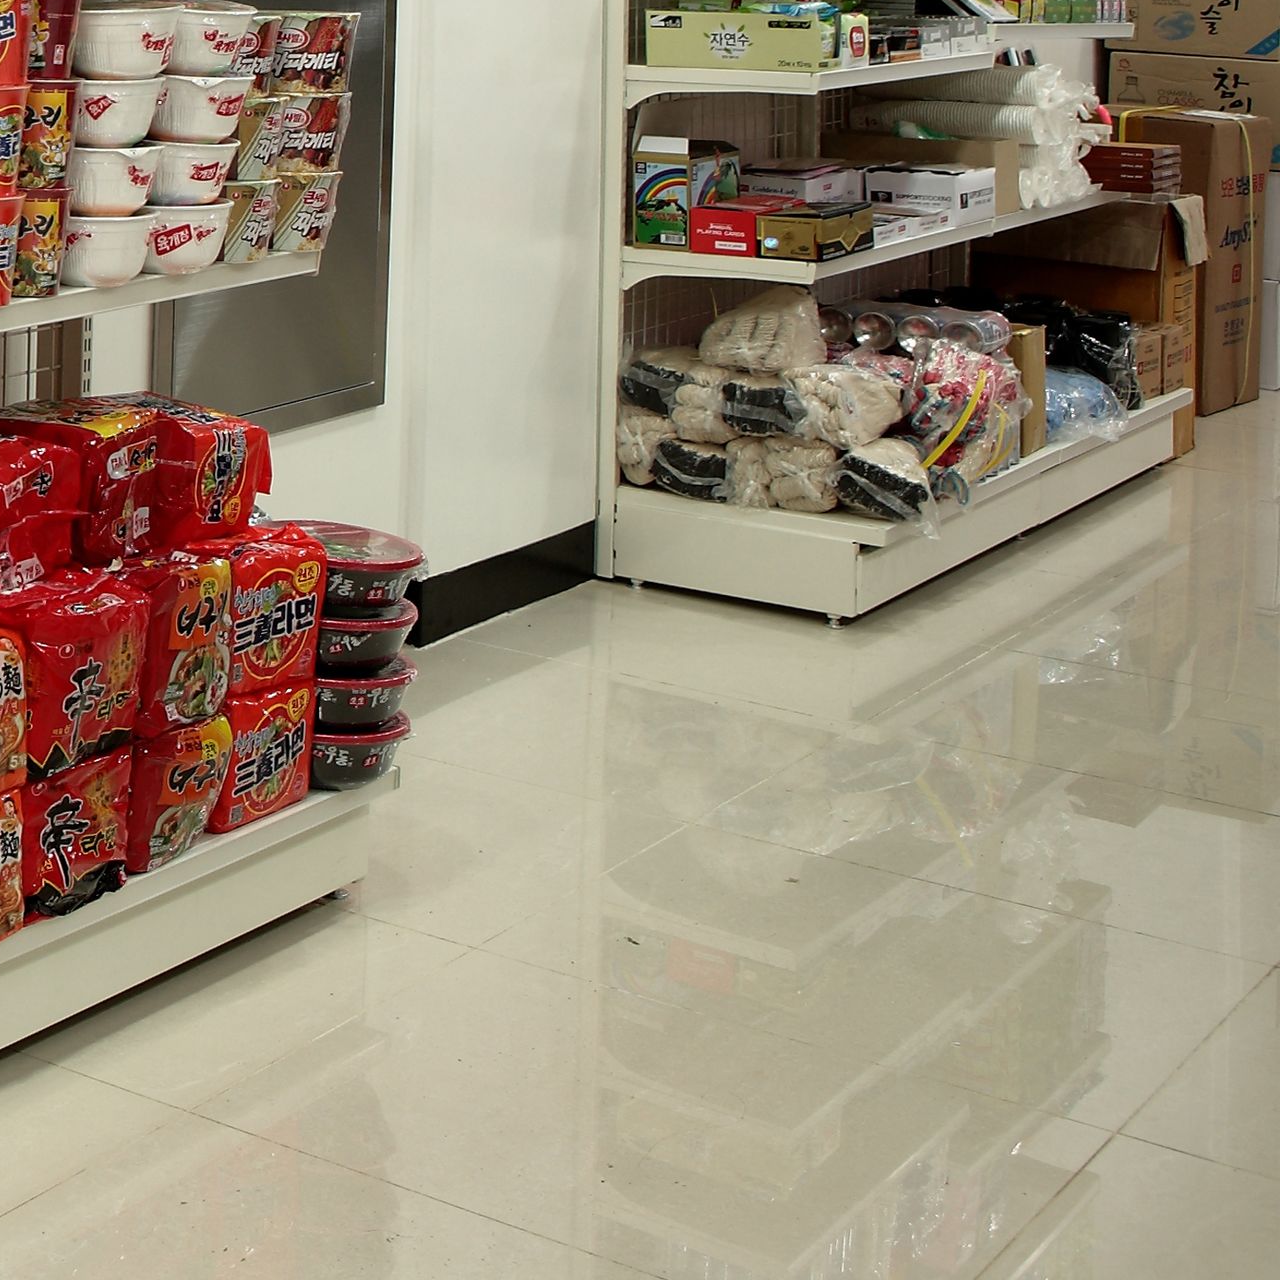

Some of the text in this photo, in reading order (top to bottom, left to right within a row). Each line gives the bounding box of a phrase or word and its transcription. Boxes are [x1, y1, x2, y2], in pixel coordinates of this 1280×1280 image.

[709, 32, 750, 48] 자연수
[156, 230, 191, 254] 육개장
[297, 566, 316, 581] 원조
[40, 795, 90, 890] 辛
